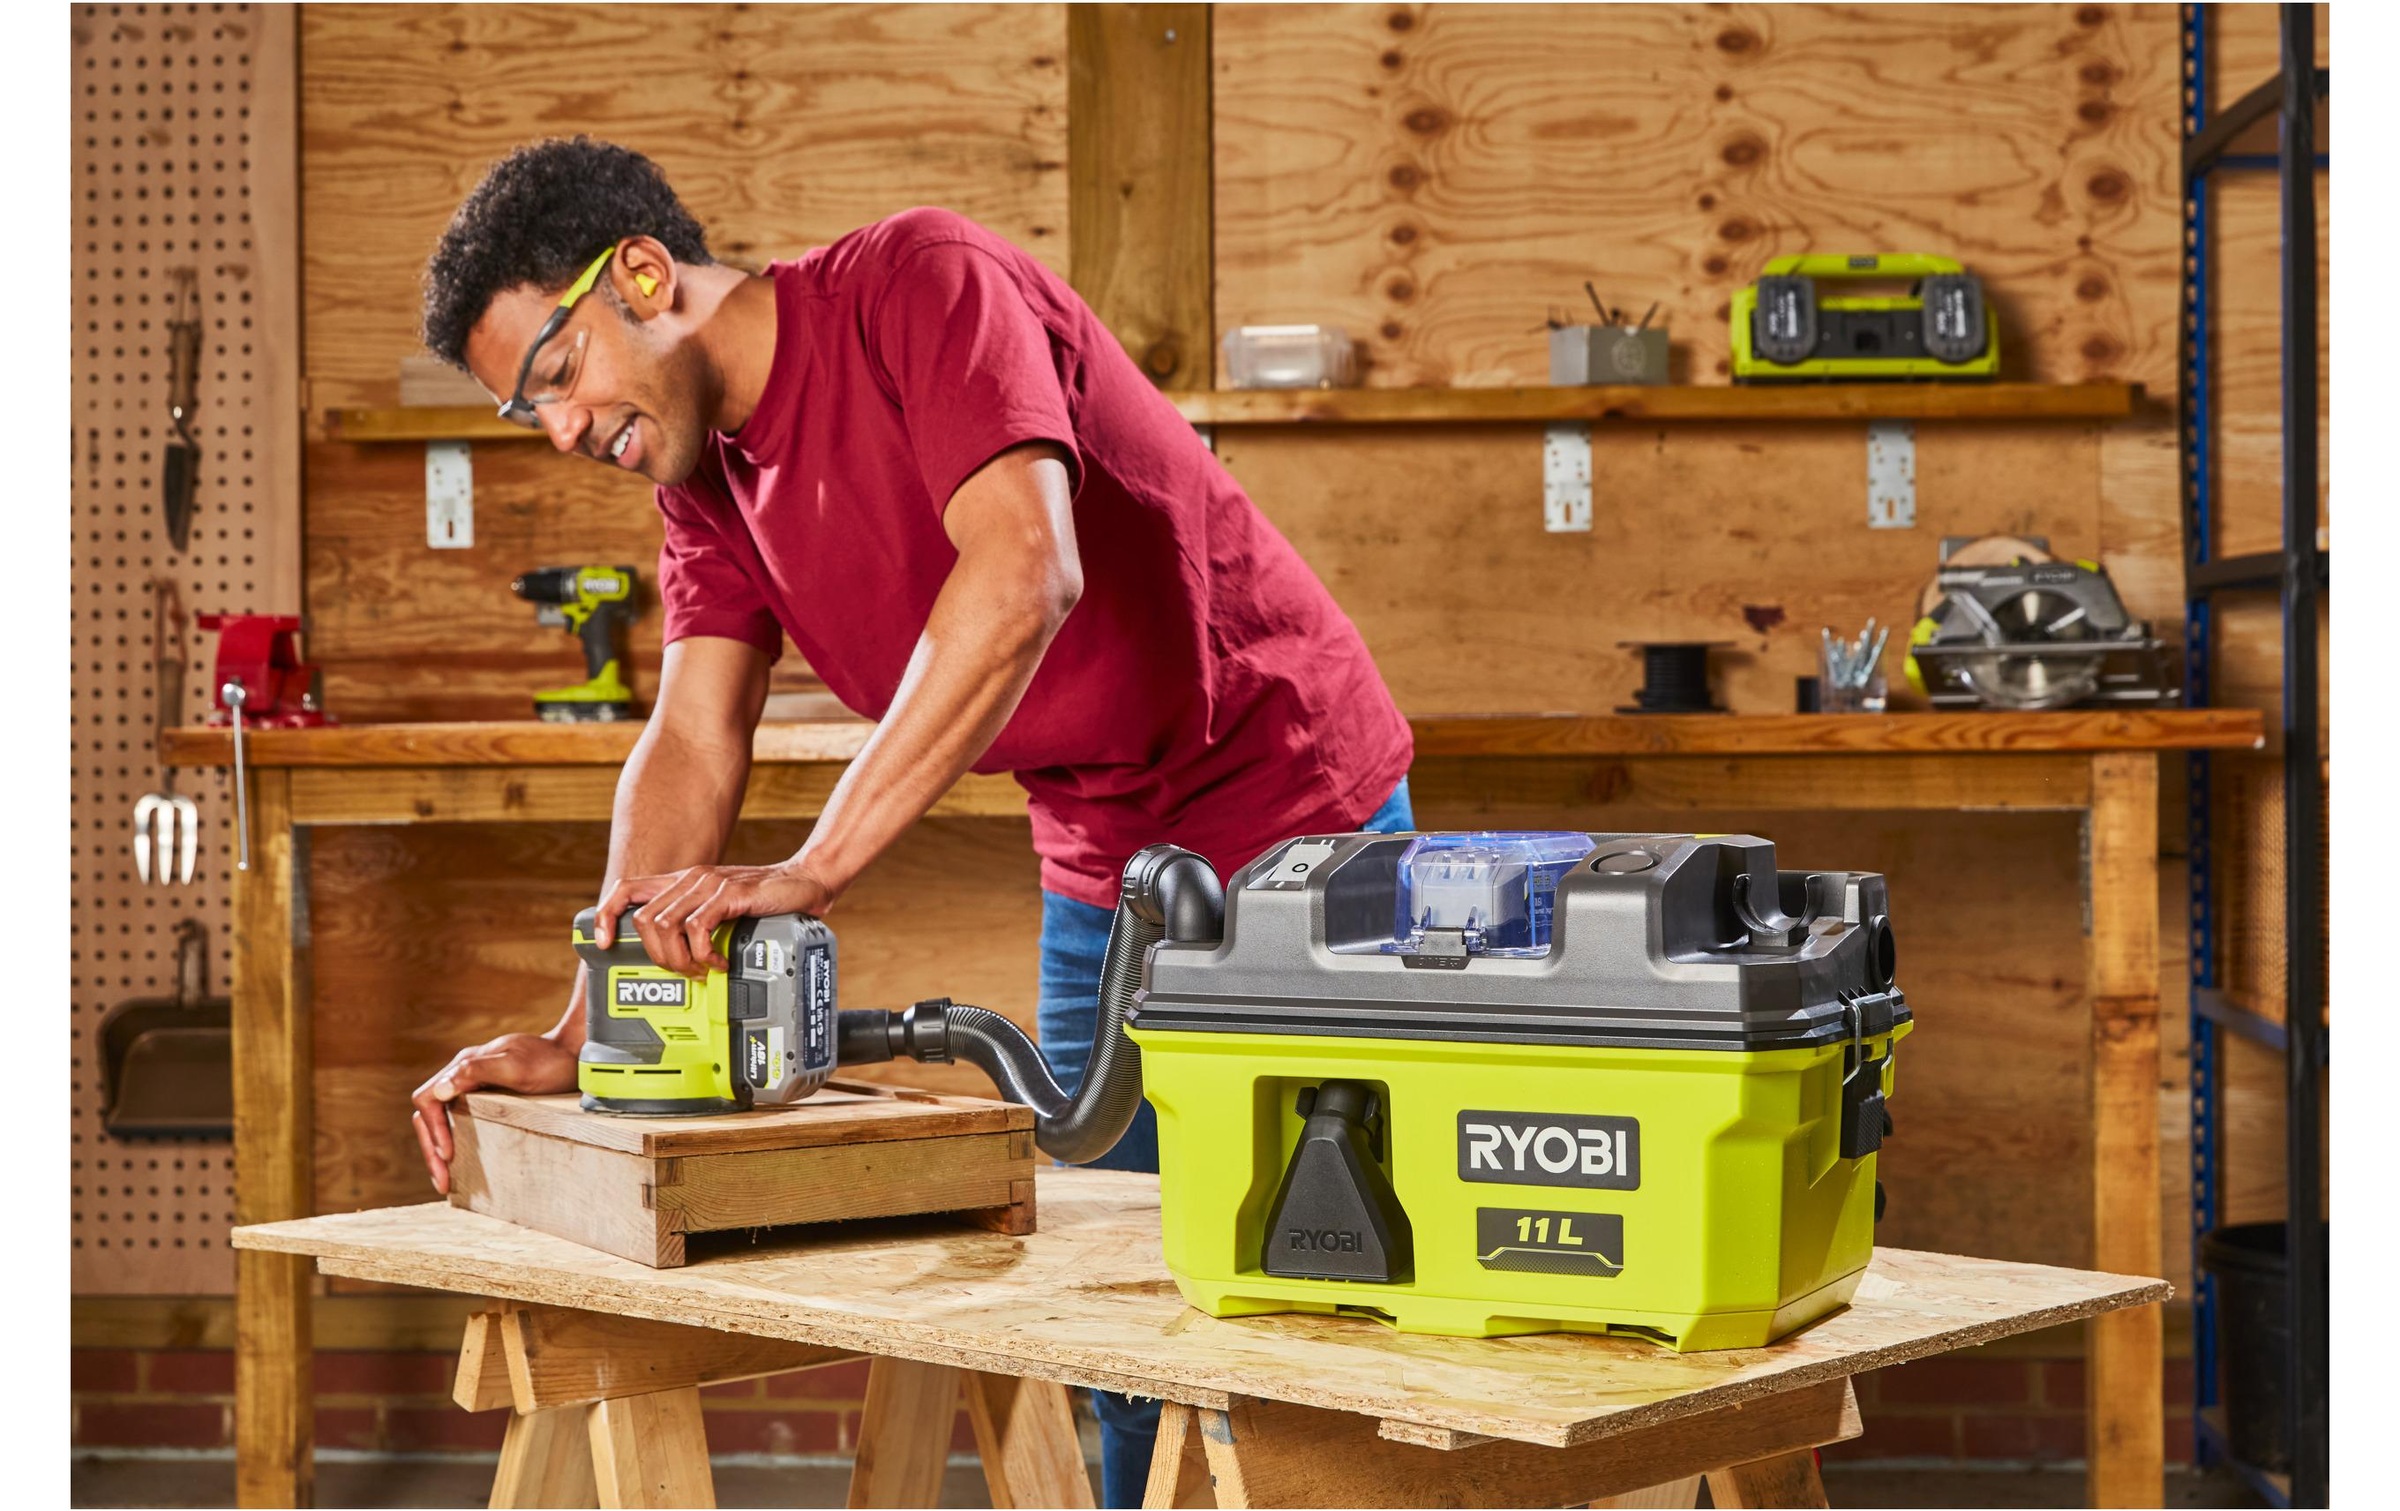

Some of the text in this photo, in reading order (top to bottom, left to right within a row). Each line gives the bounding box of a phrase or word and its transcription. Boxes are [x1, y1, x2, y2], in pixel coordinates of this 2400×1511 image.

[618, 983, 682, 1003] RYOBI
[757, 1041, 766, 1066] 18V
[1465, 1123, 1628, 1177] RYOBI
[1289, 1228, 1362, 1255] RYOBI
[1516, 1216, 1584, 1246] 11 L
